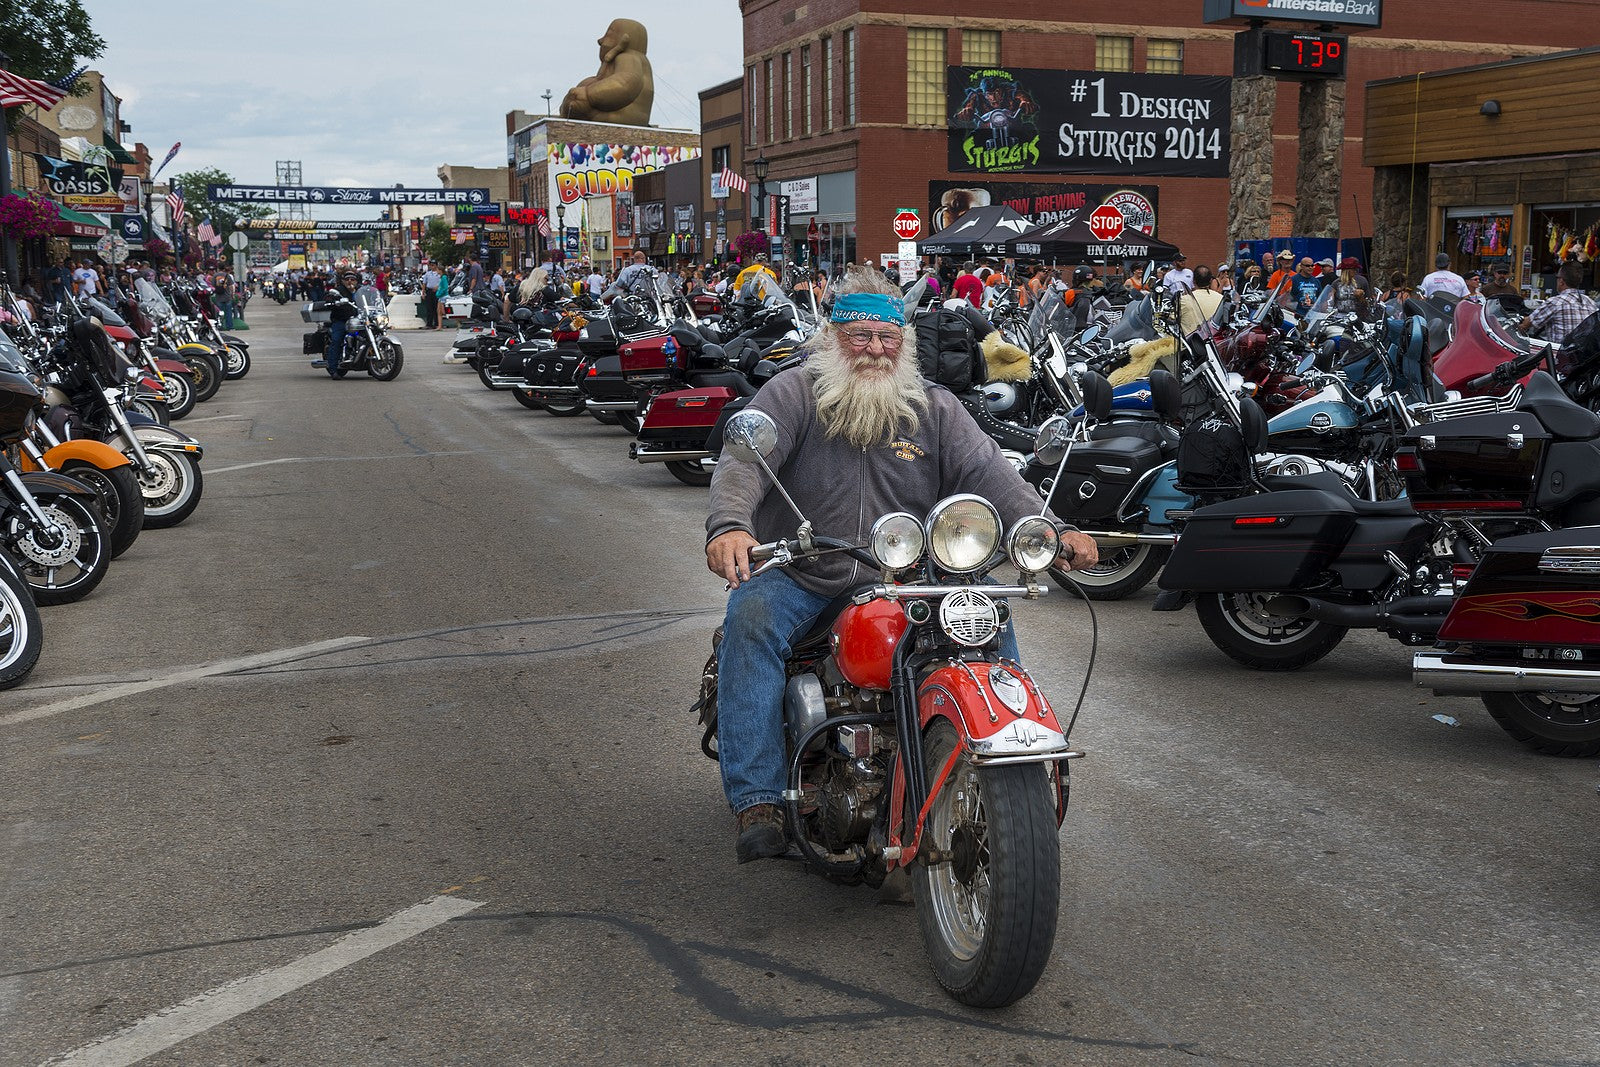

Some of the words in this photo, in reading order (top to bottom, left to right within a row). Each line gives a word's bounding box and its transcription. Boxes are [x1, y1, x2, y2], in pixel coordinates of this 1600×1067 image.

[1345, 1, 1376, 15] Bank
[1119, 91, 1211, 125] DESIGN
[1058, 122, 1157, 165] STURGIS
[1164, 126, 1222, 160] 2014
[963, 135, 1040, 168] STURGIS
[53, 181, 102, 193] OASIS
[216, 188, 308, 200] METZELER
[380, 191, 467, 202] METZELER
[70, 203, 116, 212] Budweiser
[1035, 192, 1086, 213] BREWING
[249, 219, 278, 229] RUSS
[277, 219, 317, 229] BROWN
[1036, 208, 1080, 228] DAKO
[1092, 216, 1122, 230] STOP
[895, 220, 919, 231] STOP
[835, 309, 881, 321] STURGIS
